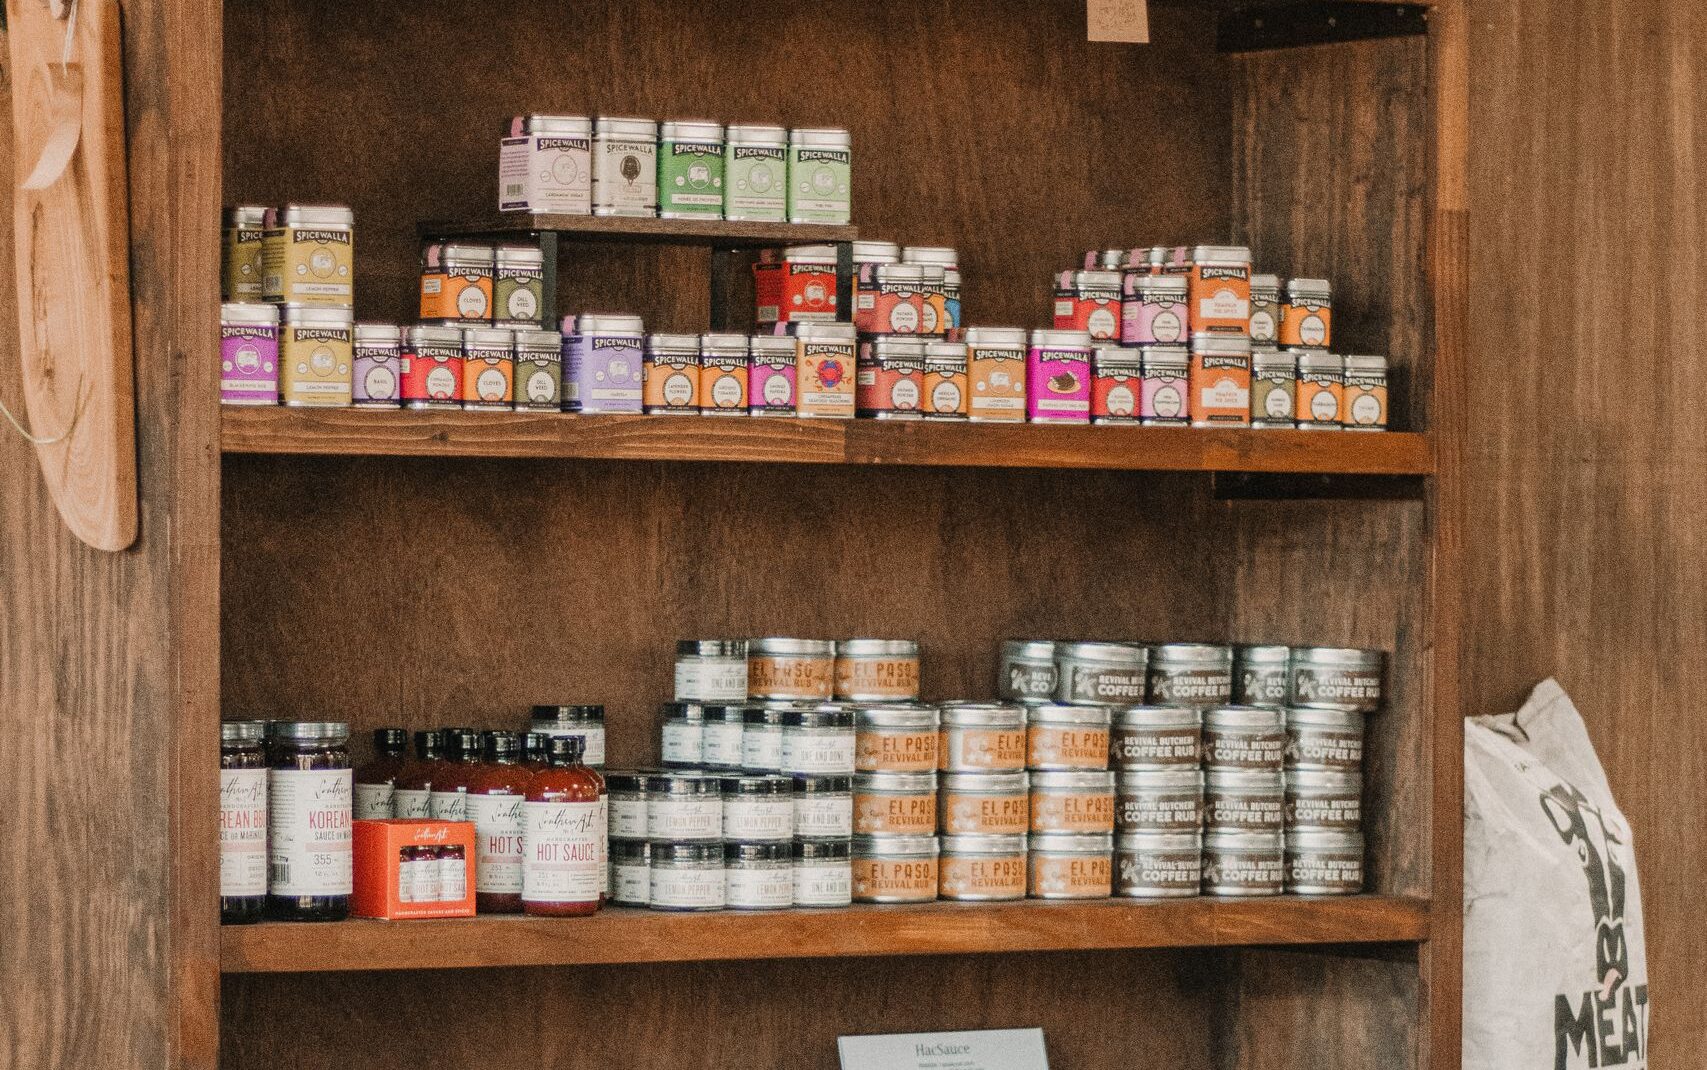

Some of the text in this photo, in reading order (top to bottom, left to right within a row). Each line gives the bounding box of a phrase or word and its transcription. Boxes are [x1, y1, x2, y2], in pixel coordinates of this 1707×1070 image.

[540, 139, 588, 151] SPICEWALLA
[606, 144, 653, 156] SPICEWALLA
[675, 144, 721, 156] SPICEWALLA
[737, 148, 783, 160] SPICEWALLA
[801, 151, 847, 163] SPICEWALLA
[297, 231, 347, 243] SPICEWALLA
[793, 264, 836, 275] SPICEWALLA
[1203, 268, 1246, 279] SPICEWALLA
[881, 284, 923, 294] SPICEWALL
[222, 327, 273, 339] SPICEWALLA
[297, 329, 347, 340] SPICEWALLA
[595, 339, 641, 349] SPICEWALLA
[807, 344, 853, 355] SPICEWALLA
[976, 350, 1023, 360] SPICEWALLA
[1043, 352, 1088, 362] SPICEWALLA
[883, 361, 923, 371] SPICEWALL
[1203, 357, 1246, 367] SPICEWALLA
[1257, 371, 1295, 381] SPICEWALL
[1344, 377, 1386, 387] SPICEWALLA
[1098, 674, 1129, 684] REVIVAL
[1172, 676, 1206, 685] REVIVAL
[1030, 681, 1048, 692] CO
[1097, 684, 1139, 696] COFFEE
[1172, 686, 1218, 697] COFFEE
[1317, 686, 1364, 697] COFFEE
[883, 737, 897, 752] EL
[998, 735, 1010, 750] EL
[1062, 732, 1107, 748] EL PAS
[1124, 736, 1156, 746] REVIVAL
[1215, 739, 1248, 749] REVIVAL
[1124, 746, 1194, 757] COFFEE RUB
[1214, 749, 1281, 761] COFFEE RUB
[1302, 748, 1348, 760] COFFEE
[882, 753, 922, 763] REVIVAL
[889, 800, 903, 816] EL
[982, 800, 998, 816] EL
[1064, 798, 1083, 813] EL
[1124, 801, 1157, 811] REVIVAL
[1215, 801, 1247, 811] REVIVAL
[1295, 799, 1329, 809] REVIVAL
[221, 810, 250, 829] REAN
[309, 810, 350, 829] KOREAN
[1124, 811, 1195, 822] COFFEE RUB
[1213, 811, 1281, 822] COFFEE RUB
[1295, 809, 1342, 820] COFFEE
[888, 816, 925, 826] REVIVAL
[981, 816, 1015, 826] REVIVAL
[315, 831, 336, 841] SAUCE
[489, 836, 524, 855] HOT S
[536, 842, 595, 861] HOT SAUCE
[314, 854, 332, 866] 355
[1293, 859, 1326, 869] REVIVAL
[871, 863, 930, 879] EL PASO
[971, 861, 1024, 877] EL PASO
[1071, 861, 1085, 876] EL
[1141, 870, 1187, 881] COFFEE
[1221, 870, 1268, 881] COFFEE
[1292, 869, 1359, 880] COFFEE RUB
[871, 879, 910, 889] REVIVAL
[971, 878, 1010, 887] REVIVAL
[1555, 985, 1648, 1070] MEAT
[915, 1043, 971, 1057] HacSauce
